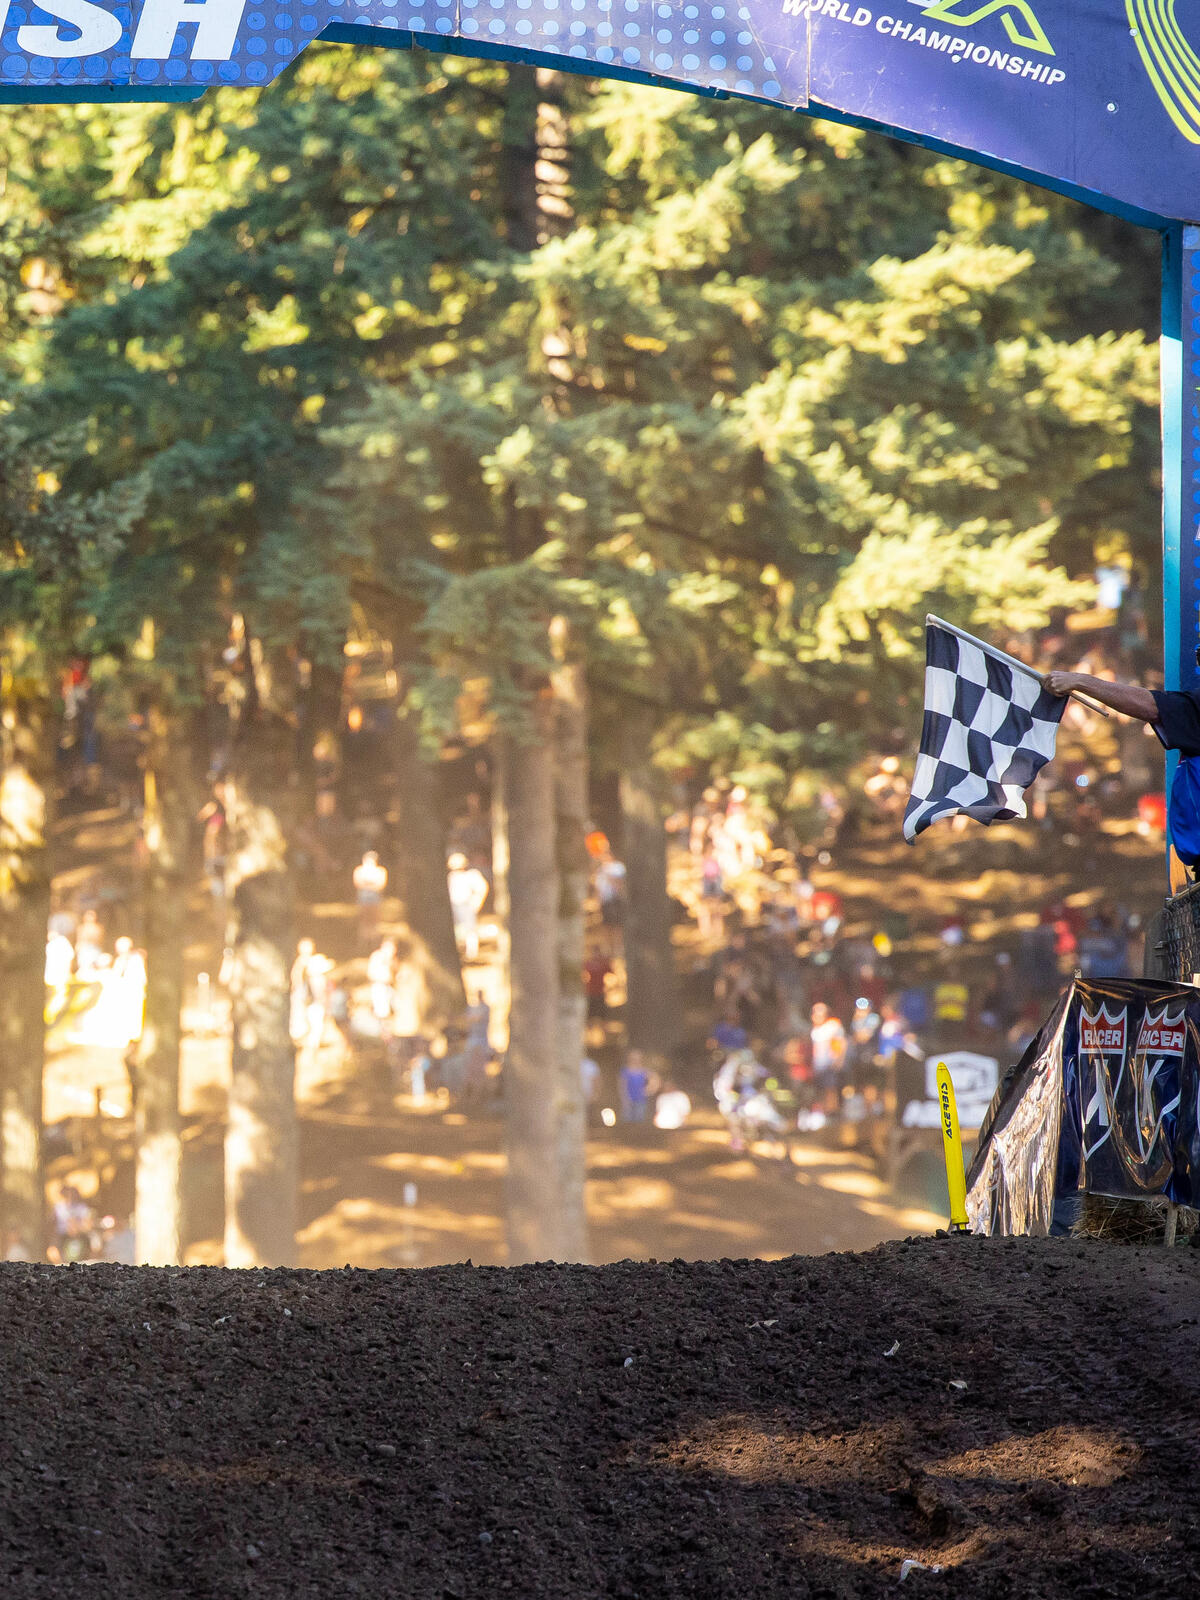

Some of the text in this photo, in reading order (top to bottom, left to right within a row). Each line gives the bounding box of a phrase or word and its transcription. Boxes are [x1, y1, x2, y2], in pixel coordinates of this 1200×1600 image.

[782, 0, 872, 26] WORLD
[875, 15, 1066, 86] CHAMPIONSHIP
[1083, 1029, 1122, 1046] RACER
[1140, 1030, 1184, 1048] RACER
[940, 1082, 953, 1139] ACERBIS
